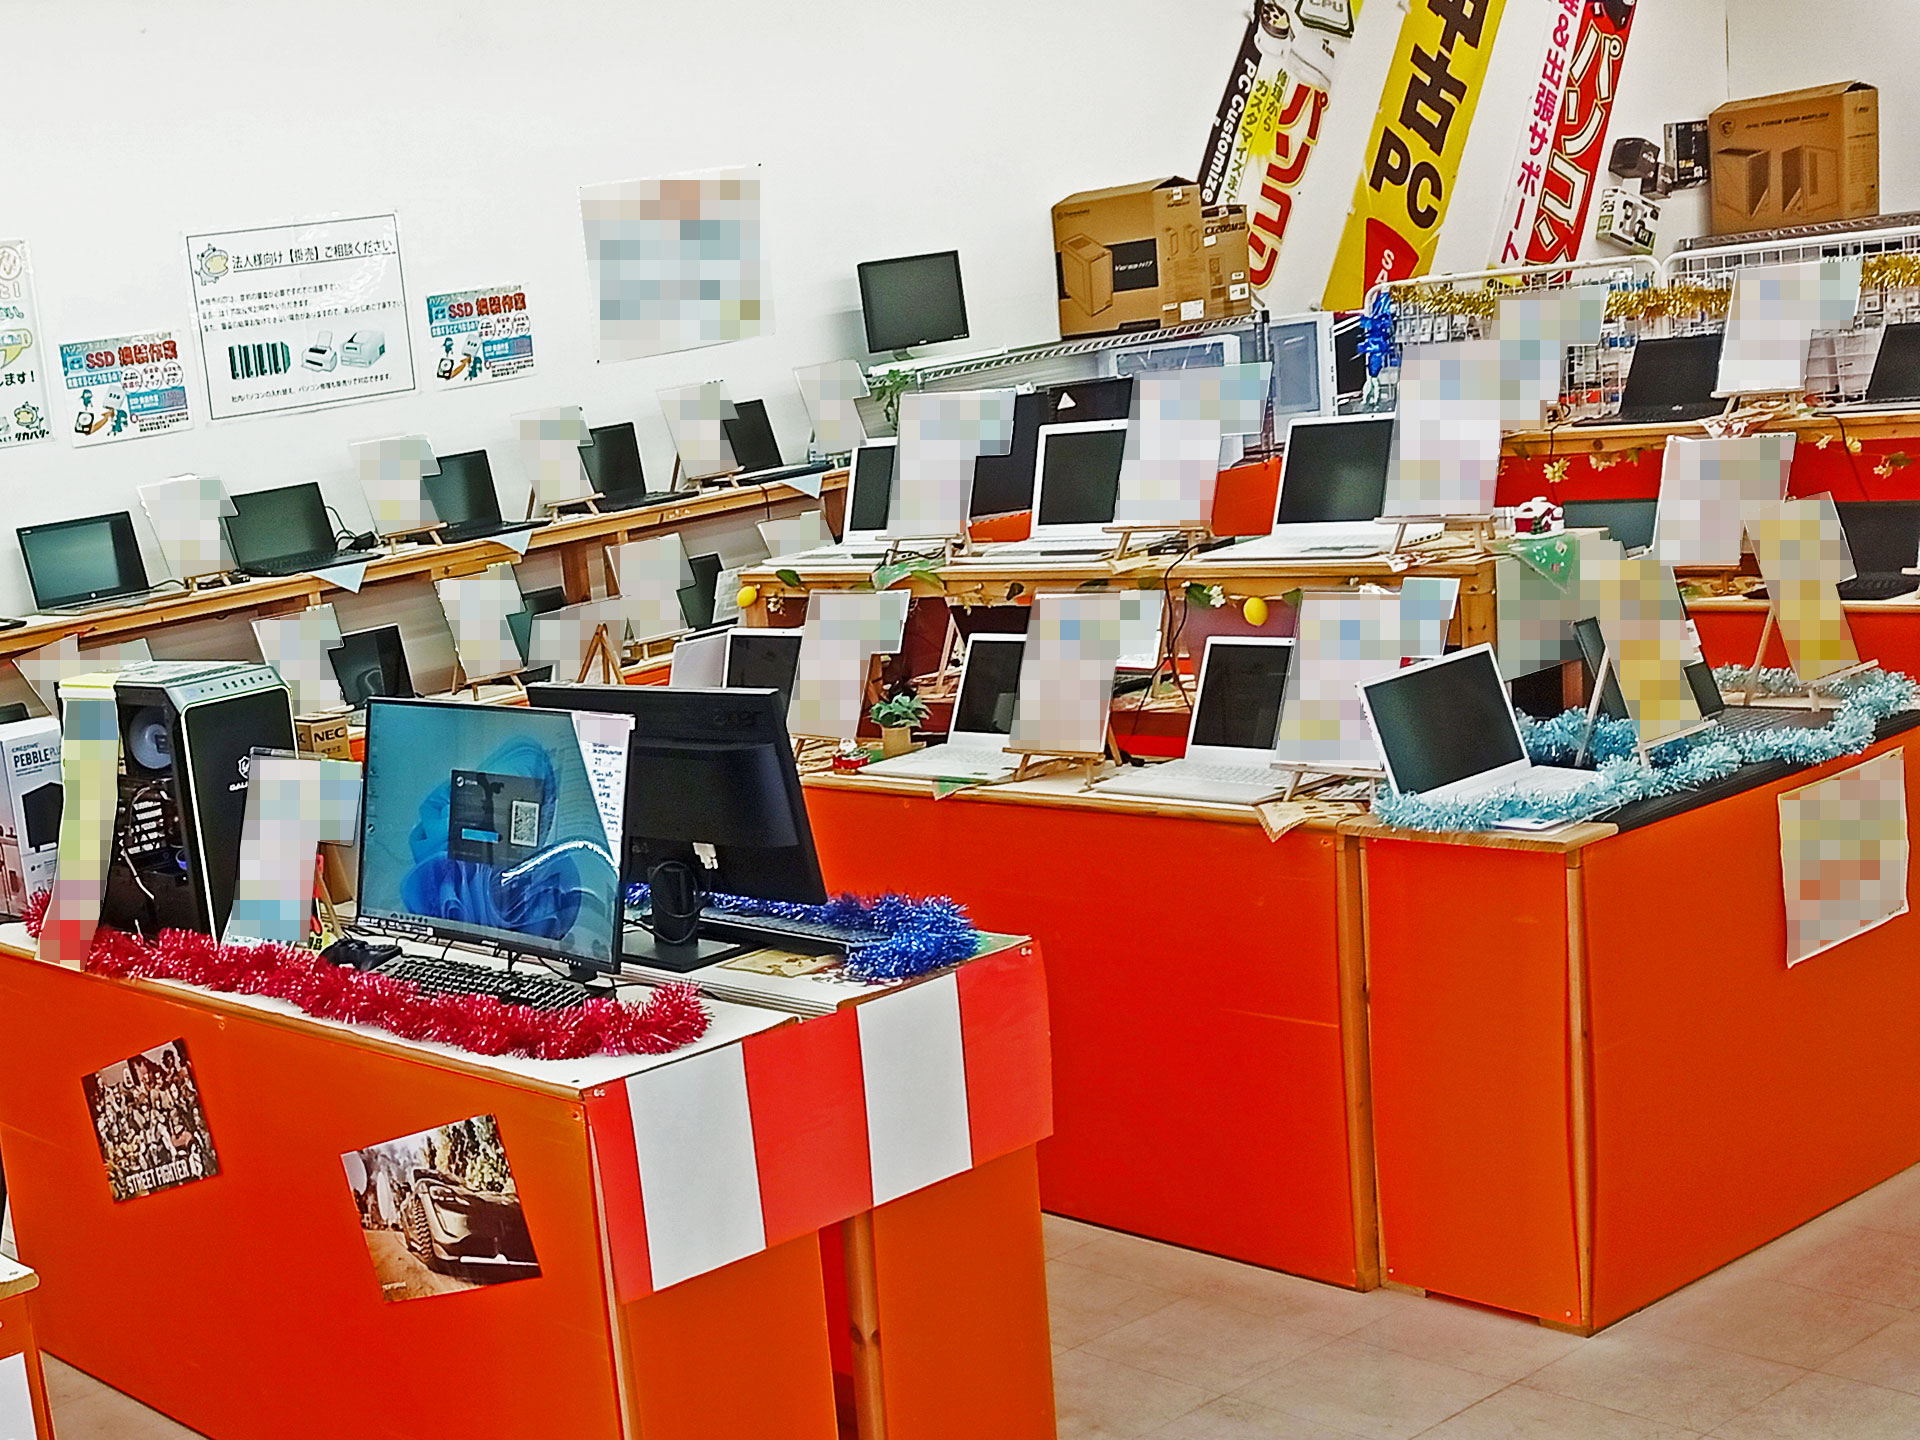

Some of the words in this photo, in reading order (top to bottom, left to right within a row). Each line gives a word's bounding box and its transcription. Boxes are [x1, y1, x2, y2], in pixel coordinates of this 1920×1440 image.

[1238, 57, 1257, 94] PC
[1202, 94, 1245, 203] Customize
[1250, 82, 1330, 288] パソコン
[448, 302, 474, 319] SSD
[86, 351, 115, 369] SSD
[314, 727, 346, 743] NEC
[13, 748, 51, 768] PEBBLE
[126, 1168, 157, 1194] STREET
[155, 1159, 190, 1185] FIGHTER
